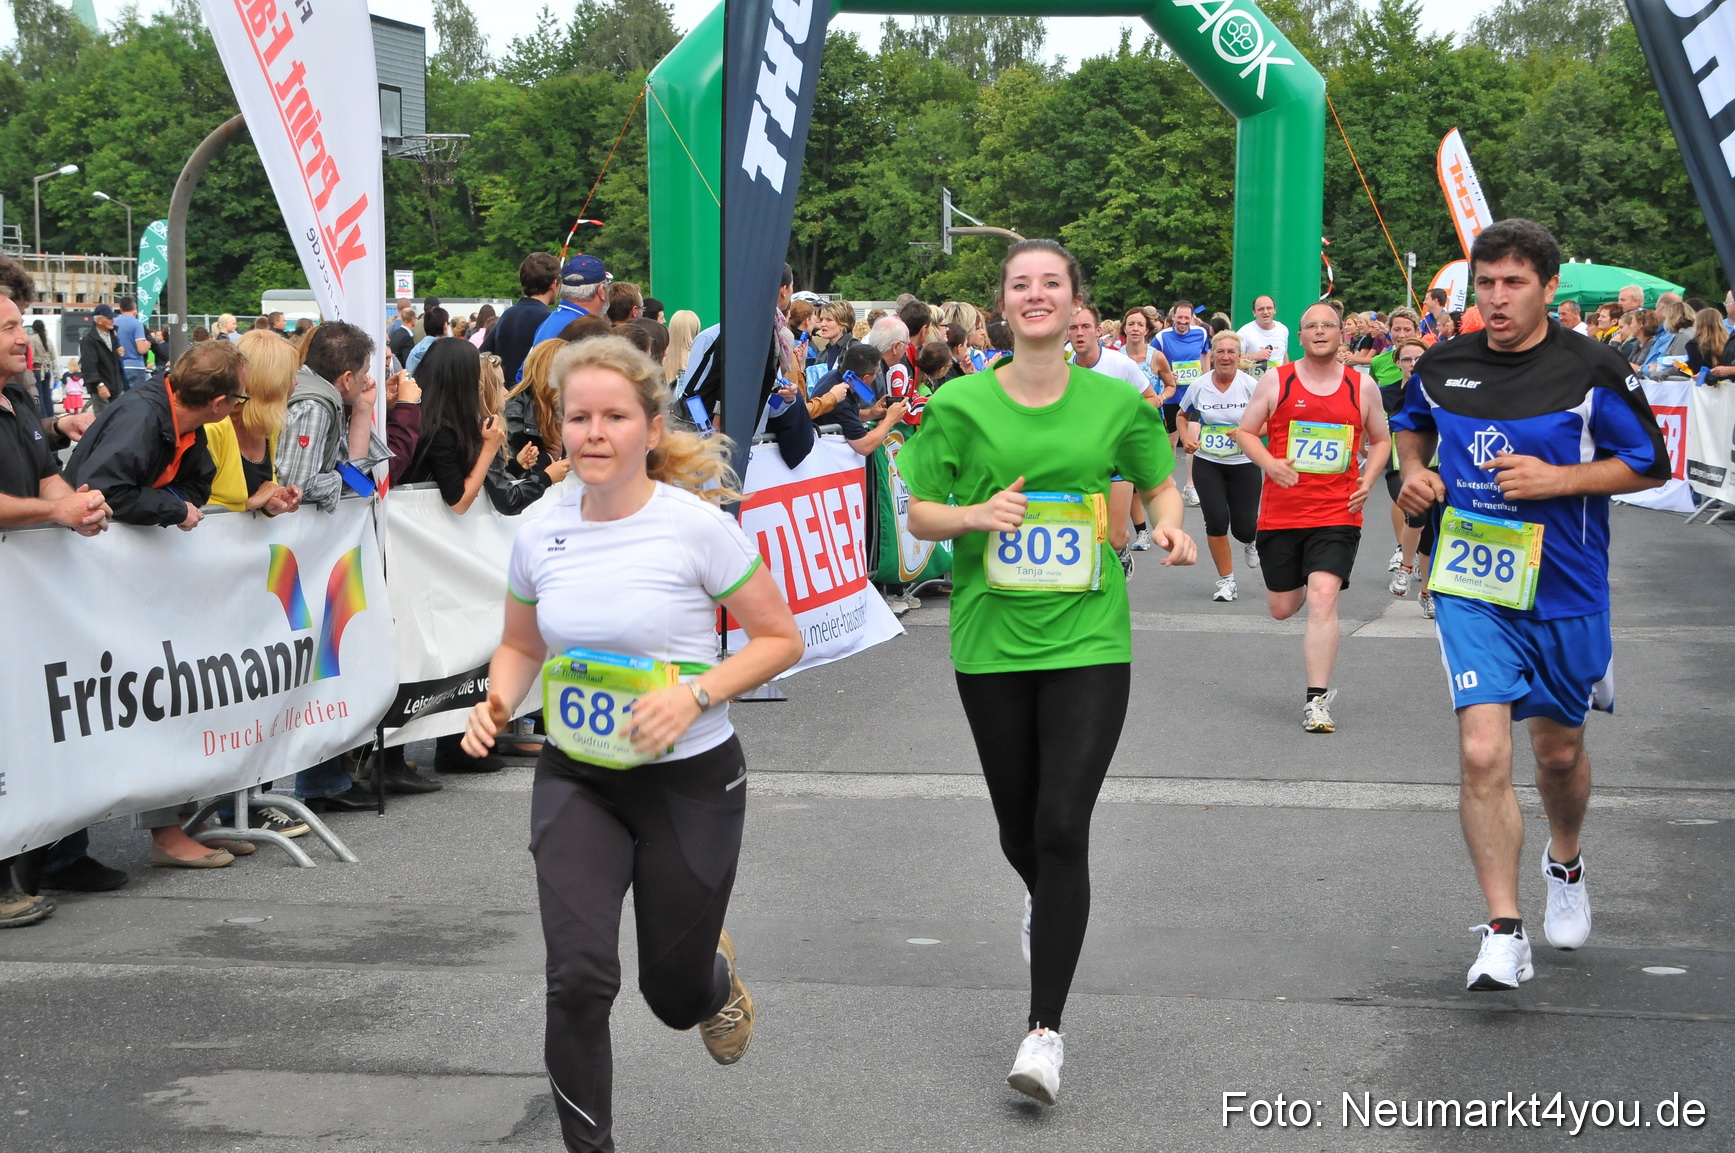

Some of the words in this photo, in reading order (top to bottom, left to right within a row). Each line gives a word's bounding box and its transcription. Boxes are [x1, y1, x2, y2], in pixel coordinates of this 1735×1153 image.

[1172, 0, 1296, 100] AOK
[1175, 369, 1198, 379] 1250
[1444, 378, 1482, 389] saller
[1205, 434, 1235, 449] 934
[1296, 439, 1339, 461] 745
[740, 482, 867, 604] MEIER
[998, 527, 1081, 565] 803
[1016, 566, 1043, 577] Tanja
[1445, 539, 1516, 583] 298
[1454, 574, 1482, 587] Memet
[44, 635, 314, 743] Frischmann
[477, 677, 490, 693] ve
[1455, 670, 1478, 691] 10
[203, 719, 264, 757] Druck
[282, 700, 349, 734] Medien
[572, 731, 610, 749] Gudrun
